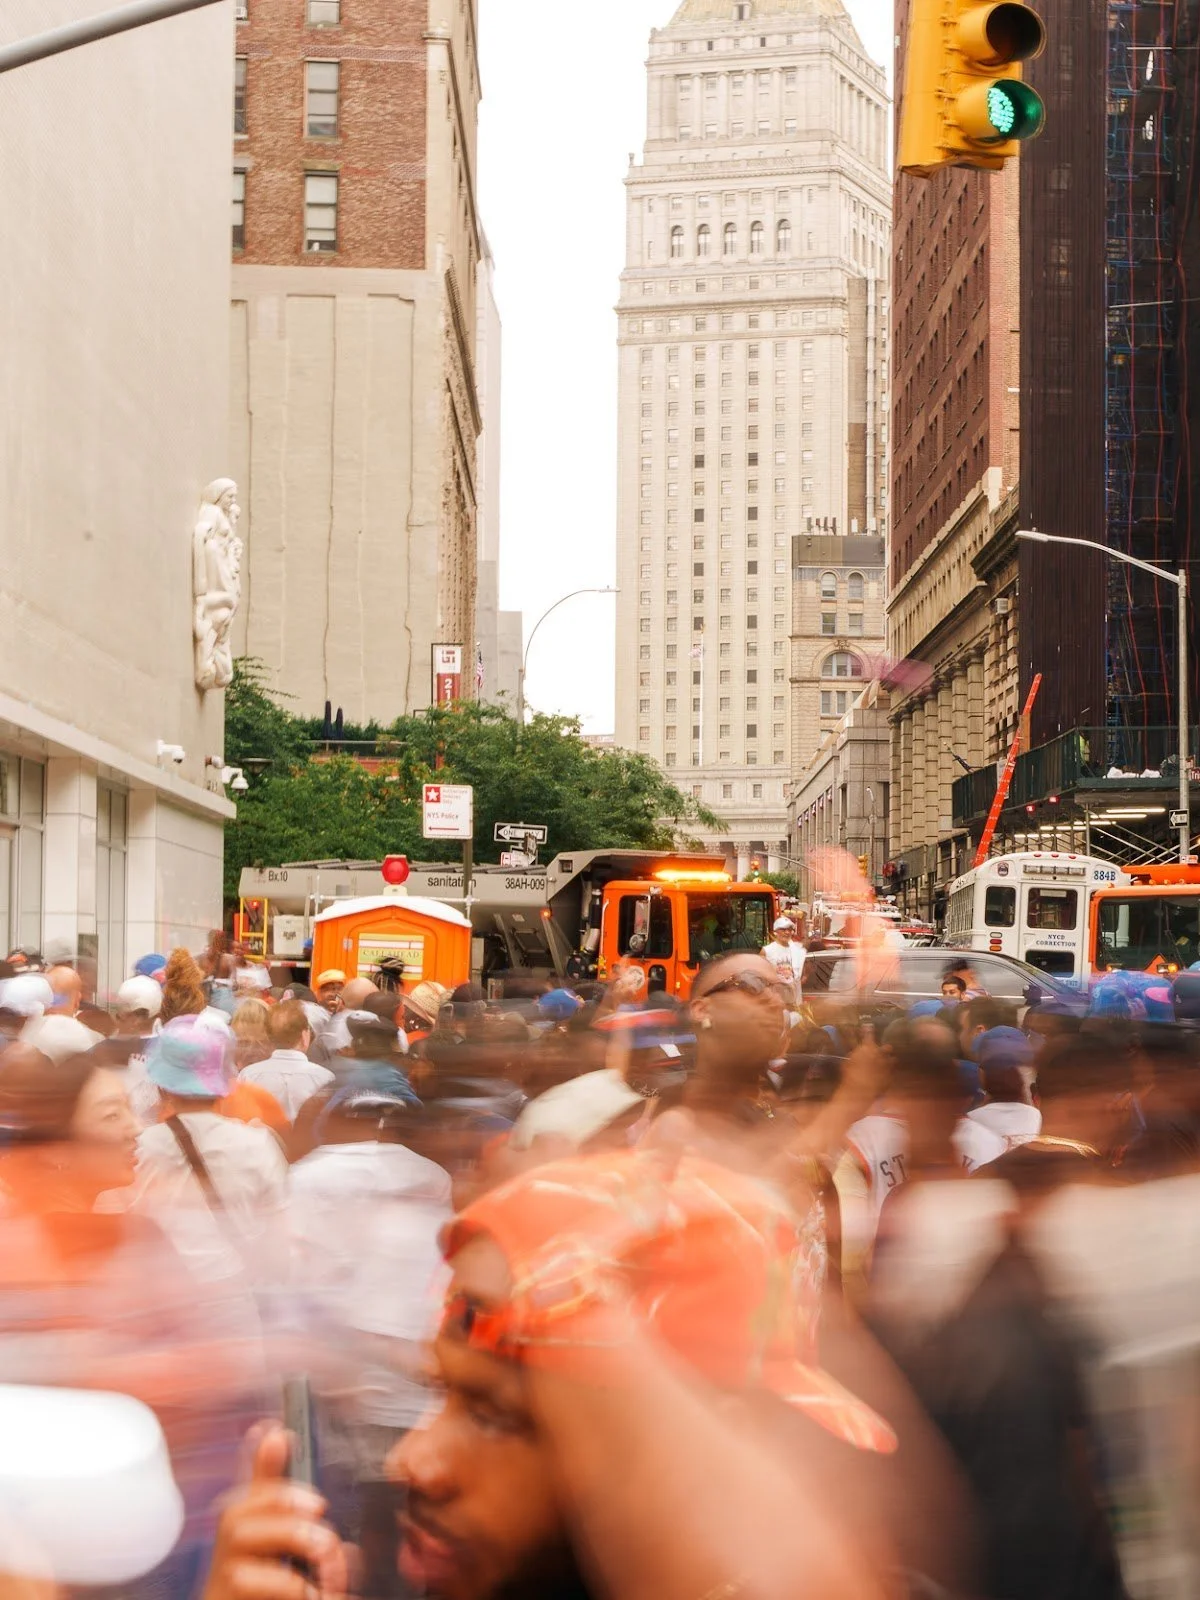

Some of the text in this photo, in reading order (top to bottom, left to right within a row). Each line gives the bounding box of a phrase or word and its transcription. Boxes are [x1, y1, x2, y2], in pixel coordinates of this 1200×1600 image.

[503, 829, 517, 837] ONE
[268, 870, 288, 882] Bx.10
[427, 875, 477, 888] sanitatin
[1094, 870, 1116, 881] 884B
[505, 878, 545, 890] 38AH-009
